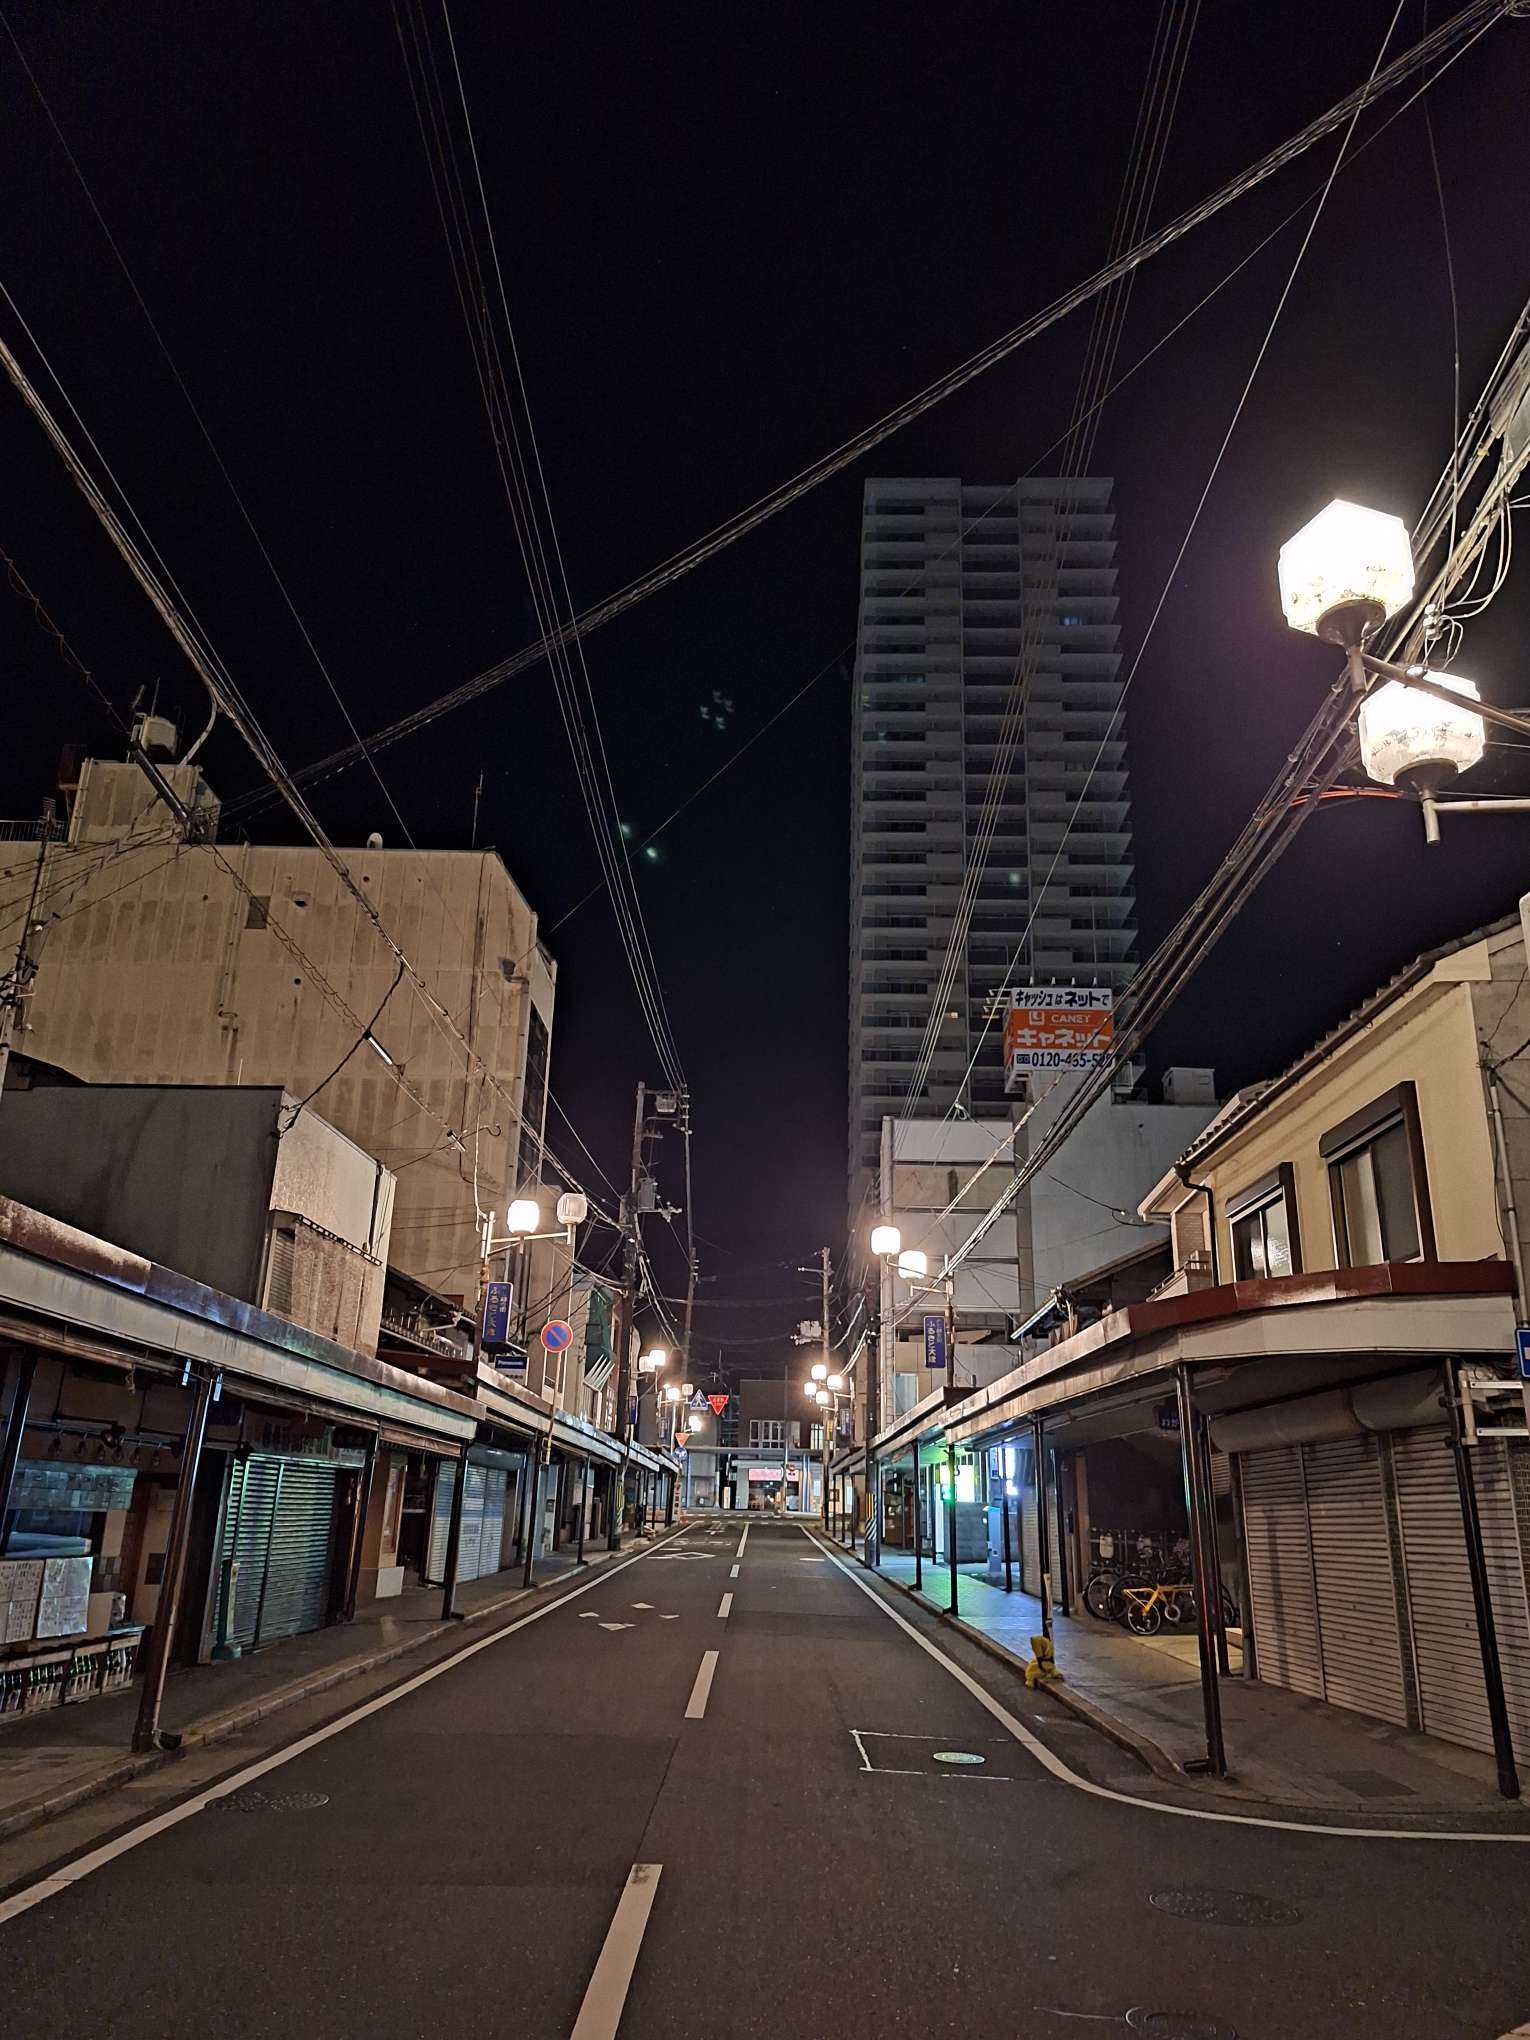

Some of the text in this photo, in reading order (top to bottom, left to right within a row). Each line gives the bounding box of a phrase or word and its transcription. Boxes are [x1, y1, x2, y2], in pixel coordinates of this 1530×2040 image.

[1015, 989, 1110, 1007] キャッシュはネットで
[1051, 1014, 1090, 1023] CANET
[1016, 1028, 1111, 1048] キャネット
